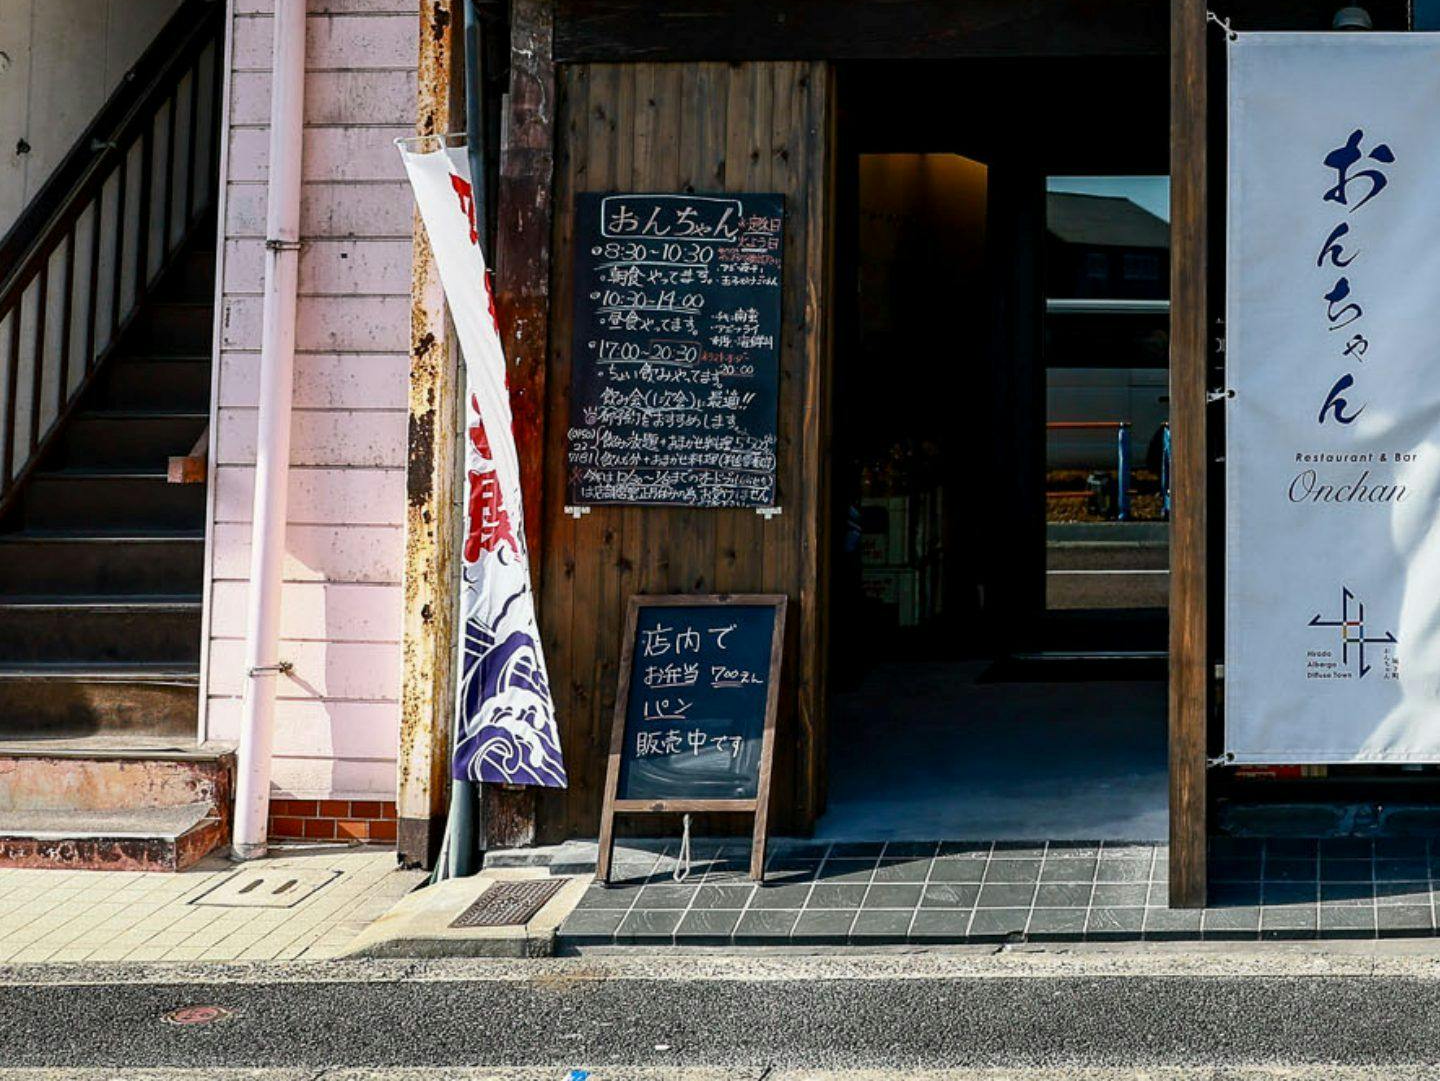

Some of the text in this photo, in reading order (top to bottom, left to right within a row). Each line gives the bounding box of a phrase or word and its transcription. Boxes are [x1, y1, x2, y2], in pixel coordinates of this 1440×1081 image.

[608, 205, 739, 238] おんちゃん
[1316, 128, 1396, 426] おんちゃん
[1295, 452, 1418, 463] Restaurant & Bar
[1288, 469, 1410, 504] Onchan
[641, 623, 738, 657] 店内で
[643, 662, 699, 686] お弁当
[643, 697, 694, 717] パン
[635, 728, 744, 758] 販売中です
